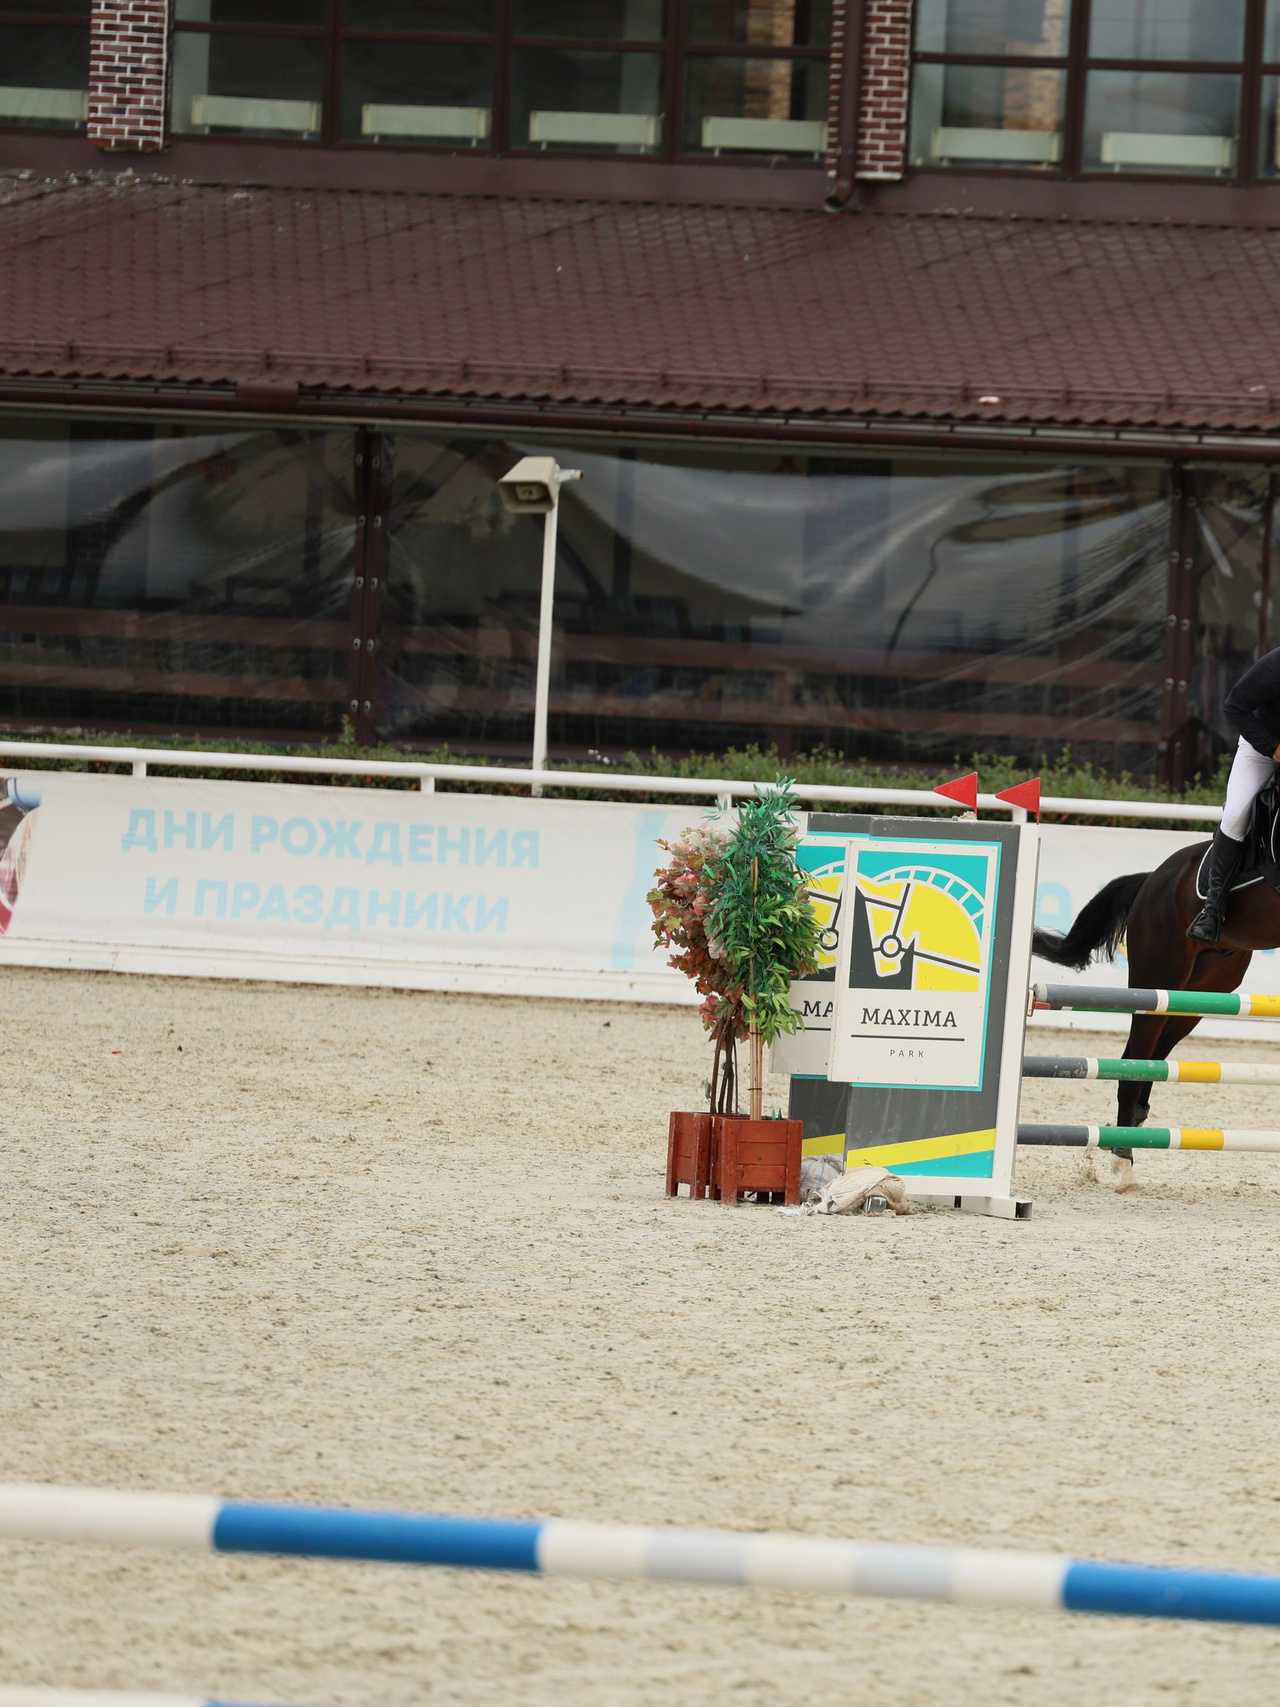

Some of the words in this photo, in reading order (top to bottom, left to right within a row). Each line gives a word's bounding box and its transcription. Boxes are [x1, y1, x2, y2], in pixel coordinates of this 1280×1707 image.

[121, 808, 234, 853] ДНИ
[251, 815, 540, 869] РОЖДЕНИЯ
[143, 877, 179, 915] И
[193, 878, 509, 932] ПРАЗДНИКИ
[860, 1007, 958, 1028] MAXIMA
[889, 1049, 925, 1058] PARK
